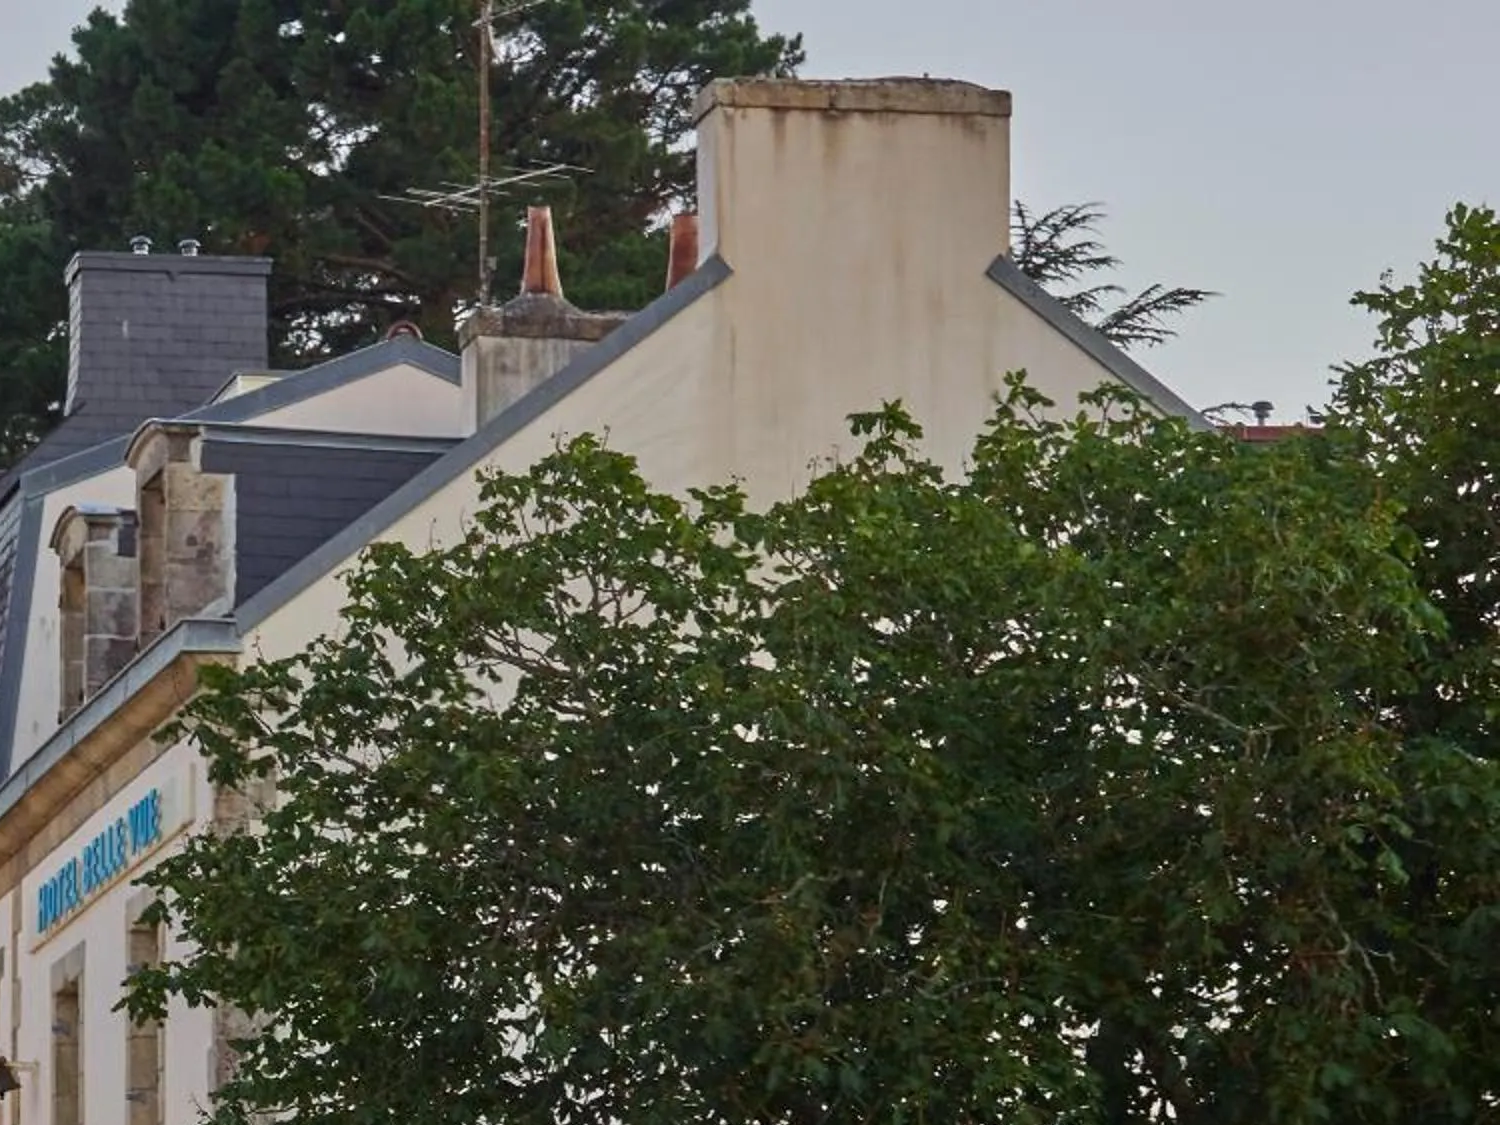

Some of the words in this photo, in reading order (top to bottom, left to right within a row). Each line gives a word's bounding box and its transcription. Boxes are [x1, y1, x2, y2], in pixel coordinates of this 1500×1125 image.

[37, 856, 81, 934] HOTEL
[82, 816, 128, 896] BELLE
[128, 787, 162, 856] VUE
